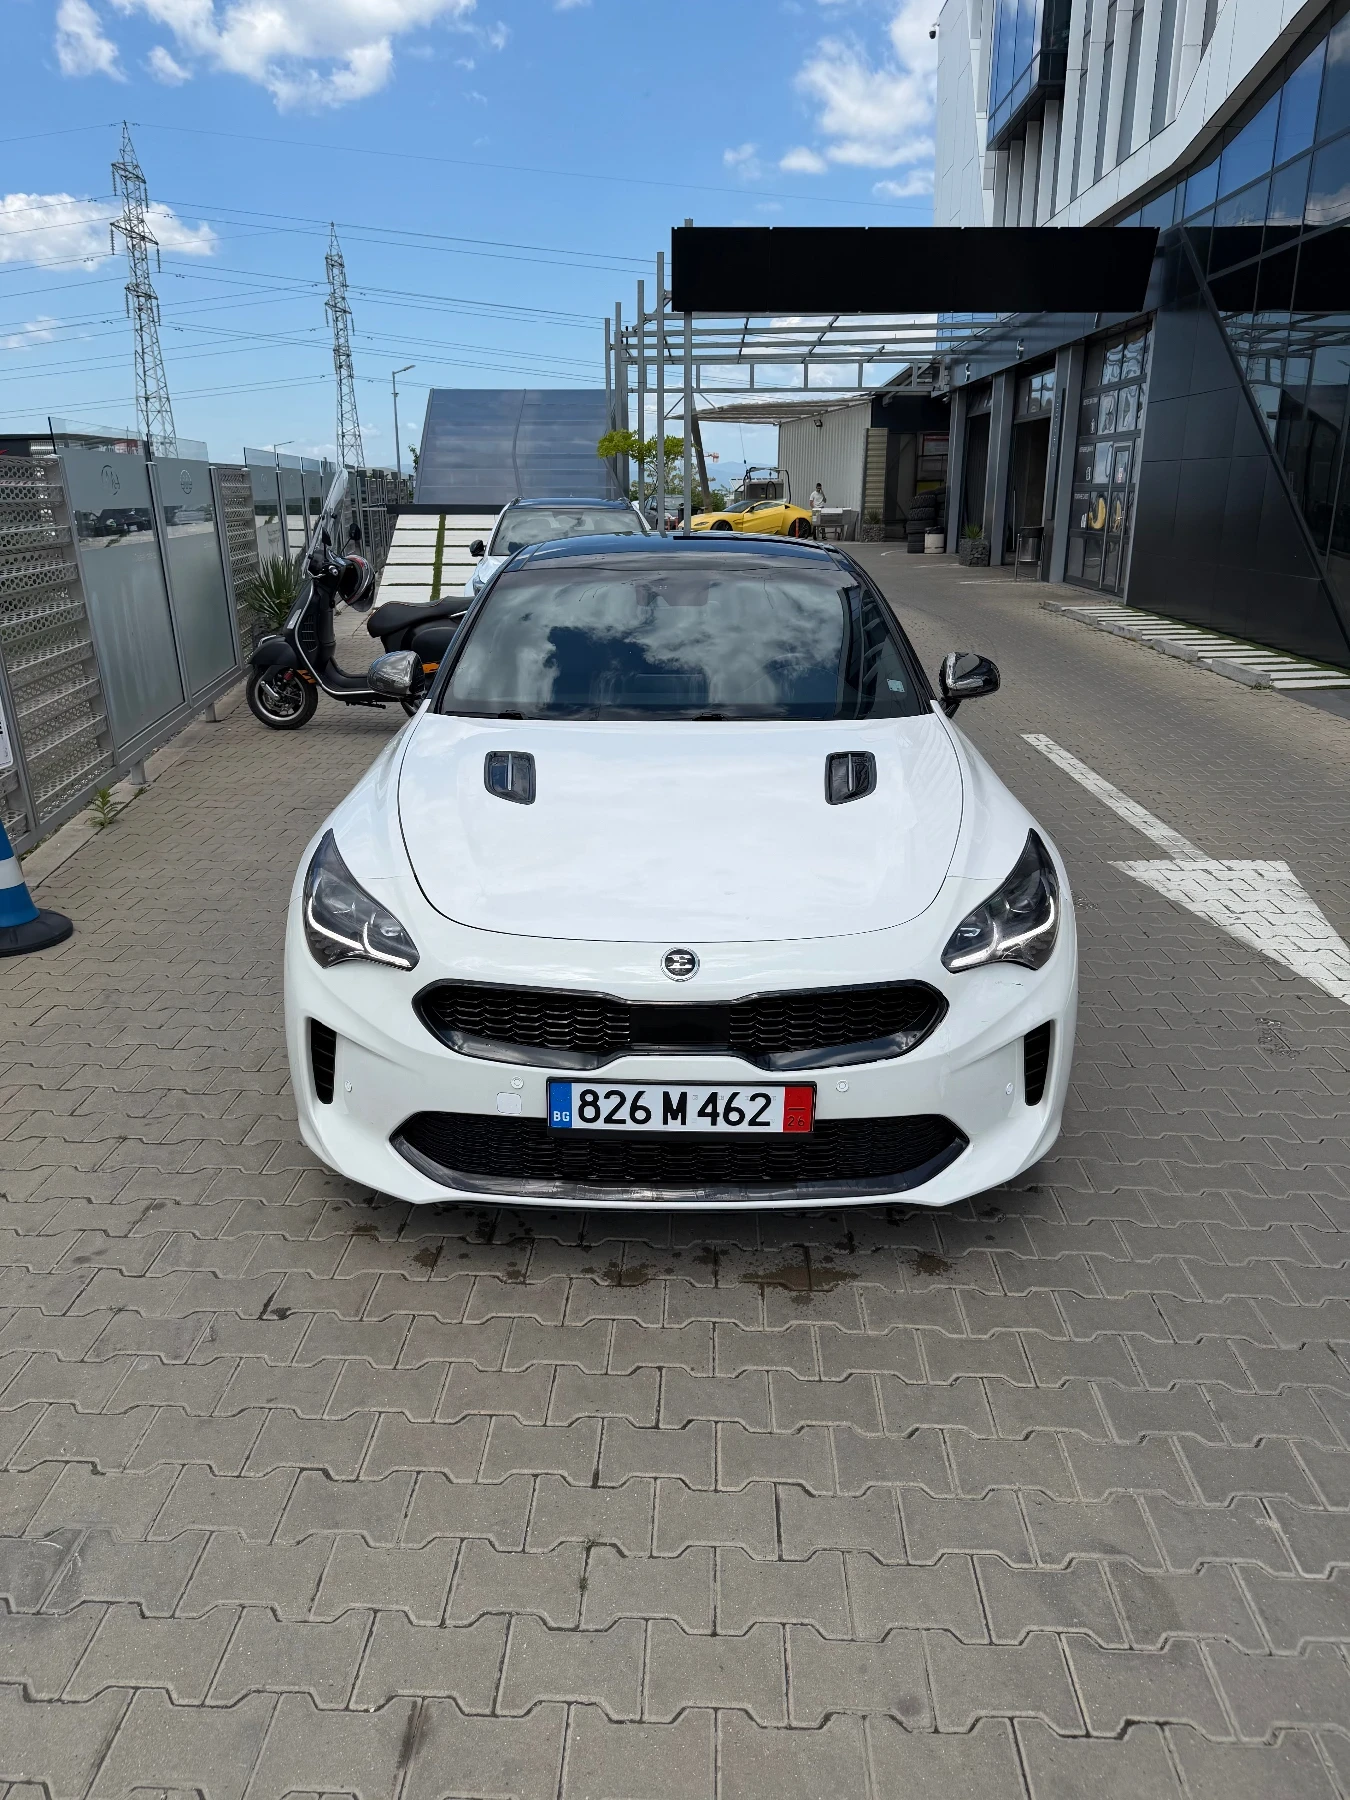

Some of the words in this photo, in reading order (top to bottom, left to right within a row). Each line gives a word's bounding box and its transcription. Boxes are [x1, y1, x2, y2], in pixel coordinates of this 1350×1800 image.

[578, 1088, 652, 1124] 826
[662, 1091, 688, 1126] M
[697, 1091, 772, 1127] 462
[553, 1110, 570, 1122] BG
[787, 1114, 806, 1127] 26
